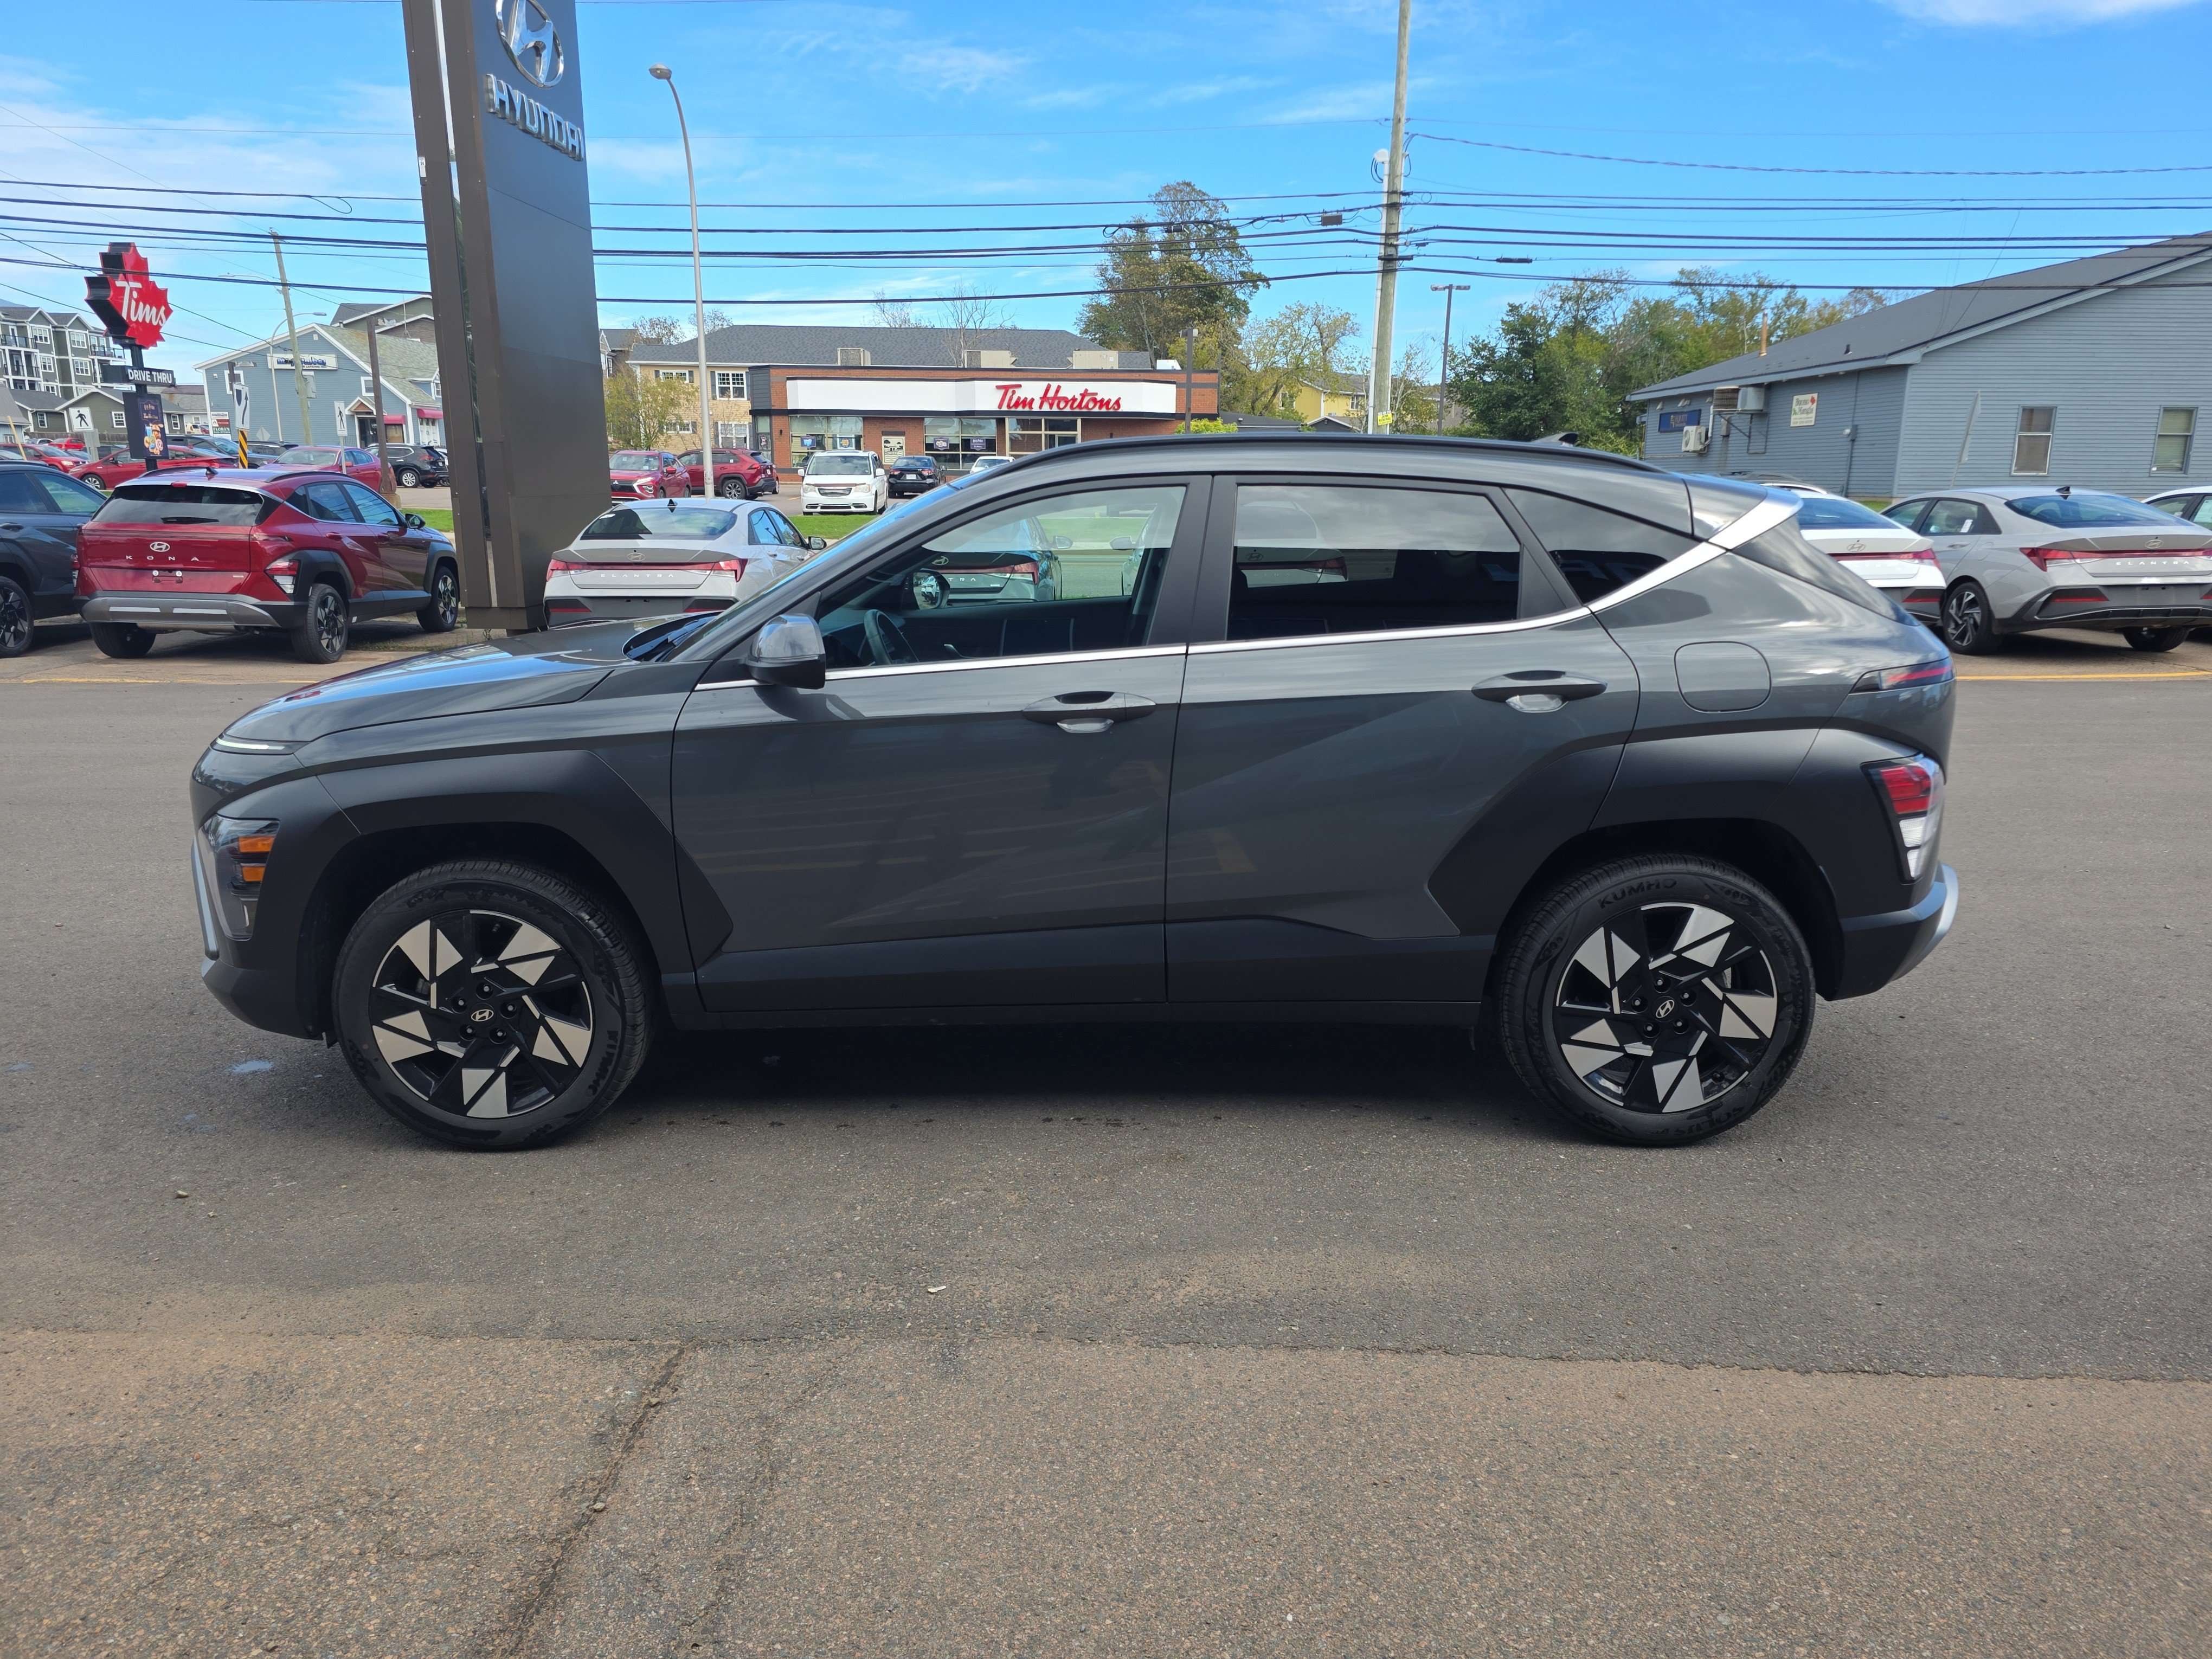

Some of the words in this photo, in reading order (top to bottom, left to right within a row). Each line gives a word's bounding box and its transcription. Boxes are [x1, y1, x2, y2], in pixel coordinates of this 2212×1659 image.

[484, 74, 584, 161] HYUNDAI
[114, 280, 166, 326] Tims
[127, 369, 151, 382] DRIVE
[152, 371, 172, 383] THRU
[995, 384, 1035, 410] Tim
[1038, 383, 1122, 410] Hortons
[1597, 877, 1678, 909] KUMHO
